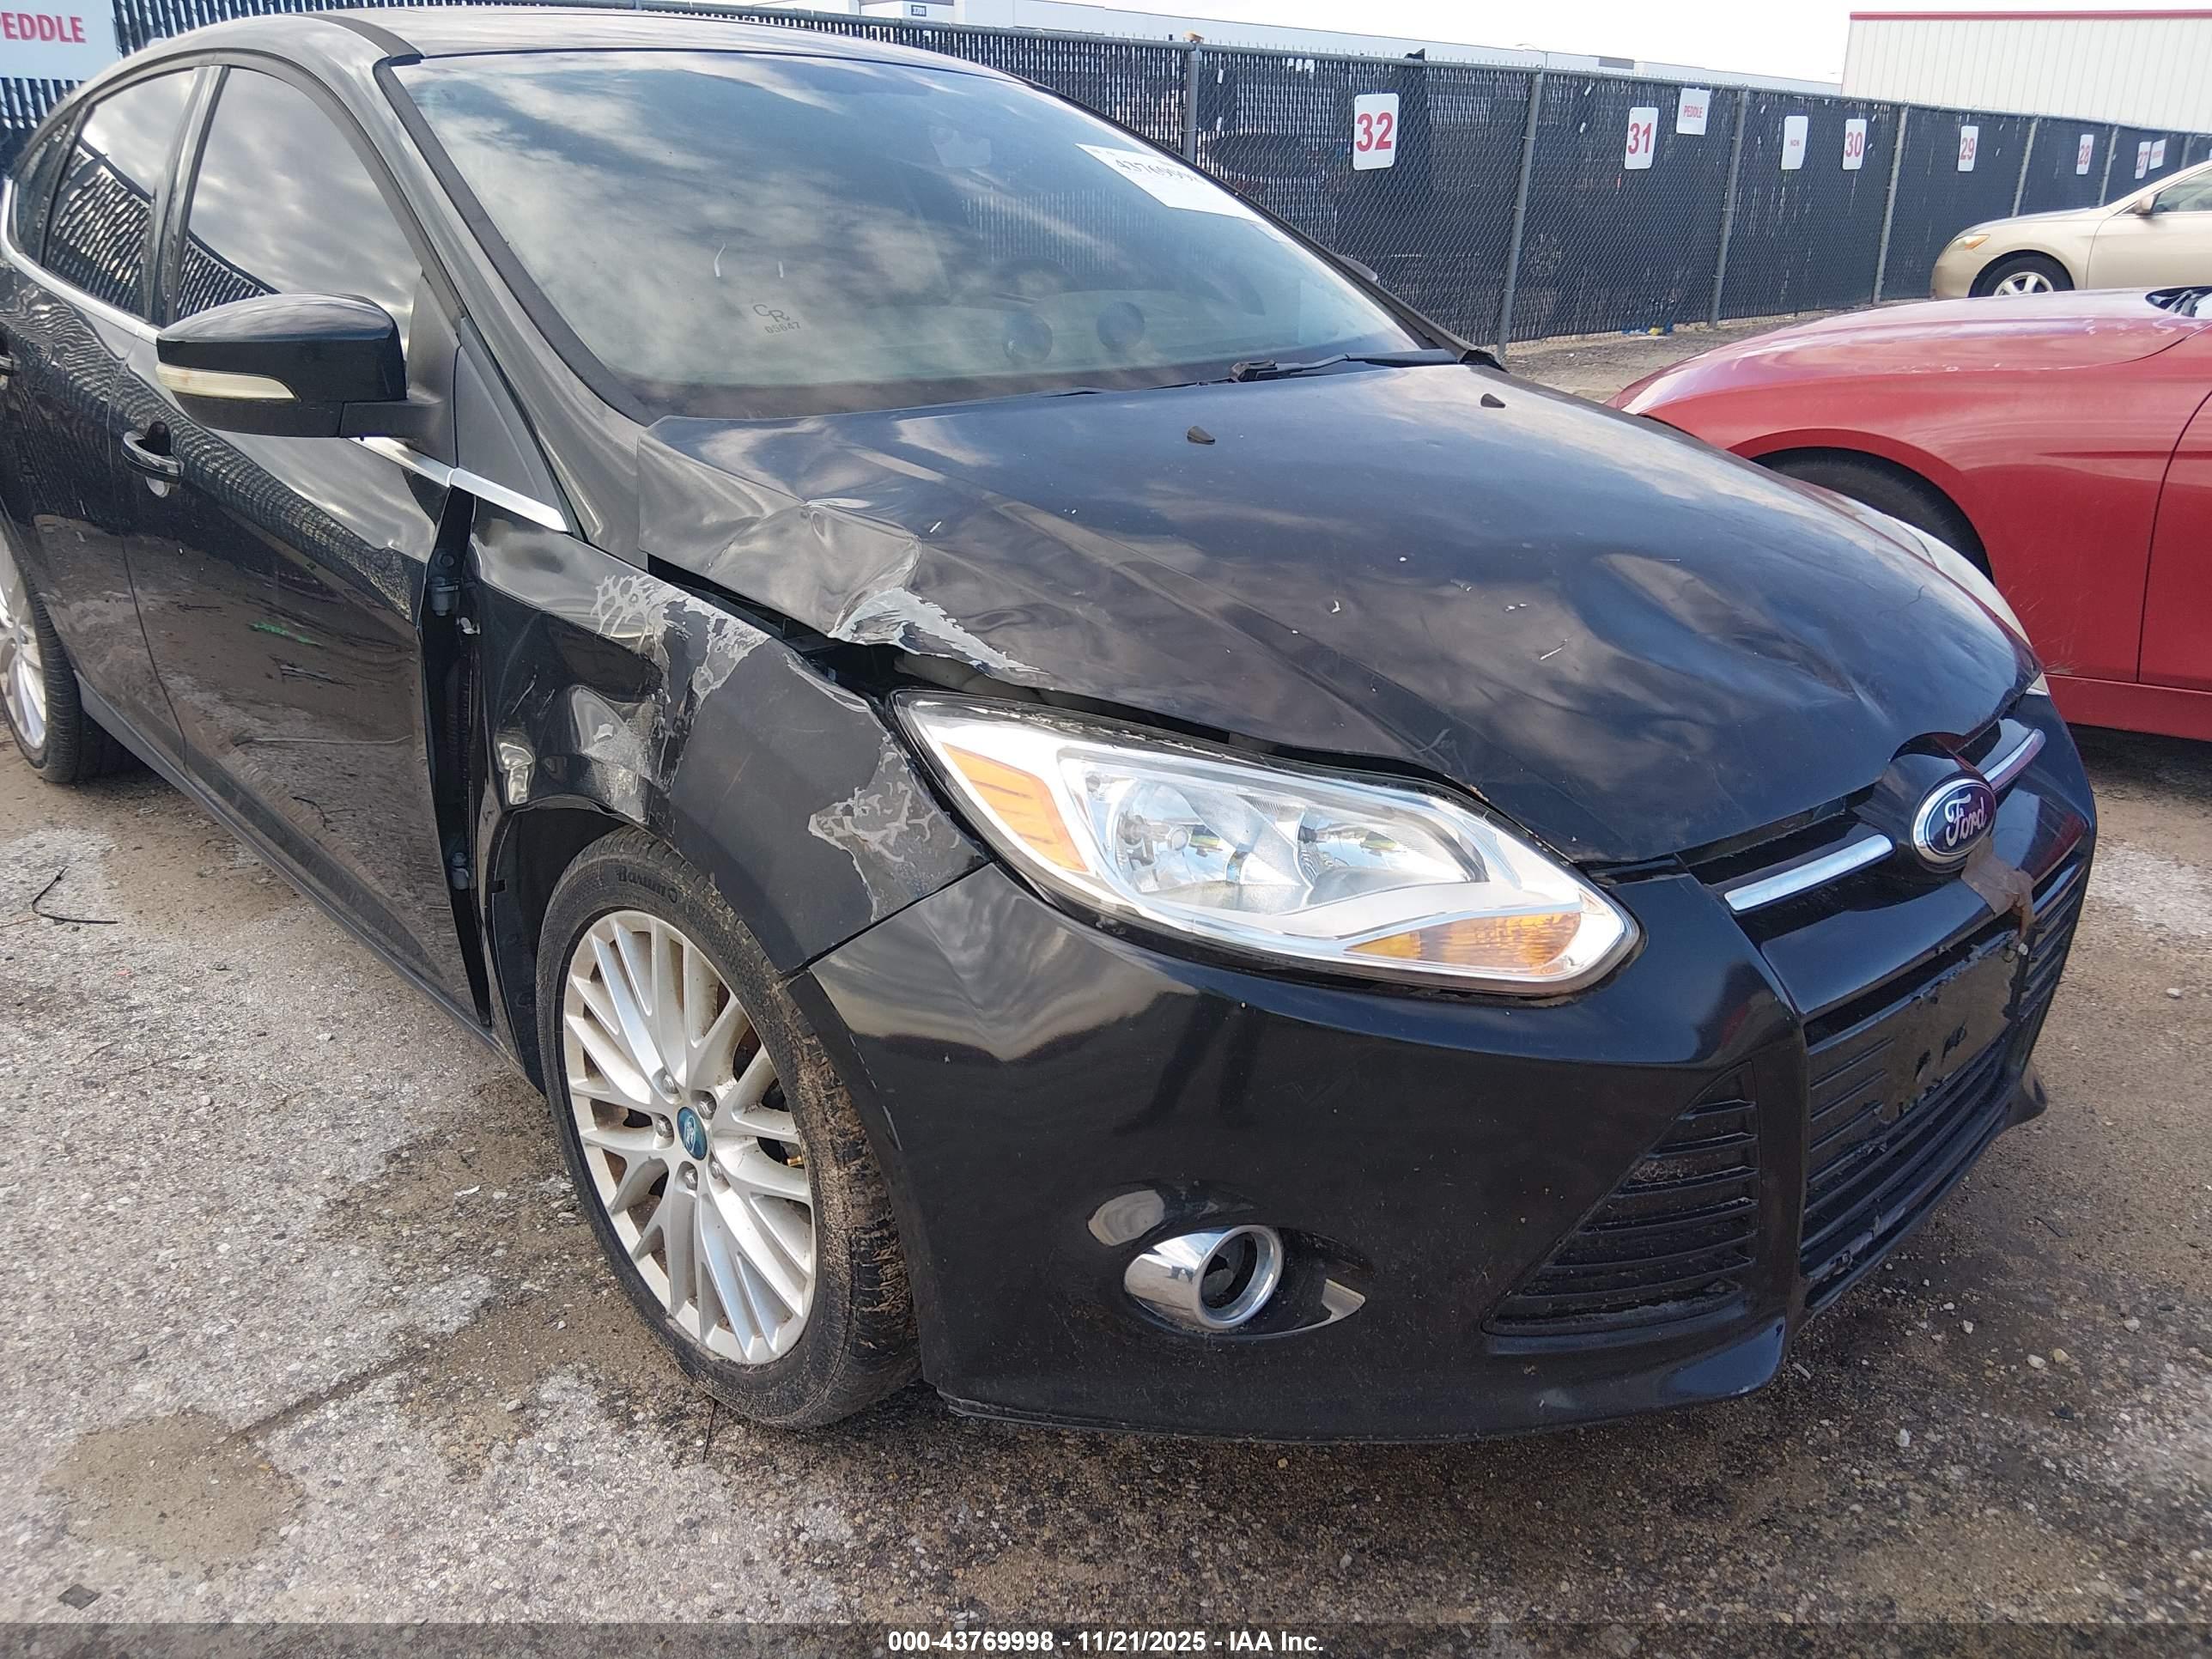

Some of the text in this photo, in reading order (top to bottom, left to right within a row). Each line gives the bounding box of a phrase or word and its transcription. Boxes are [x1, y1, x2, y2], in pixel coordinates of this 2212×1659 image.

[0, 11, 87, 44] EDDLE
[1357, 112, 1393, 151] 32
[1628, 123, 1652, 155] 31
[1845, 131, 1863, 157] 30
[1960, 137, 1974, 161] 29
[1945, 793, 1988, 848] Ford
